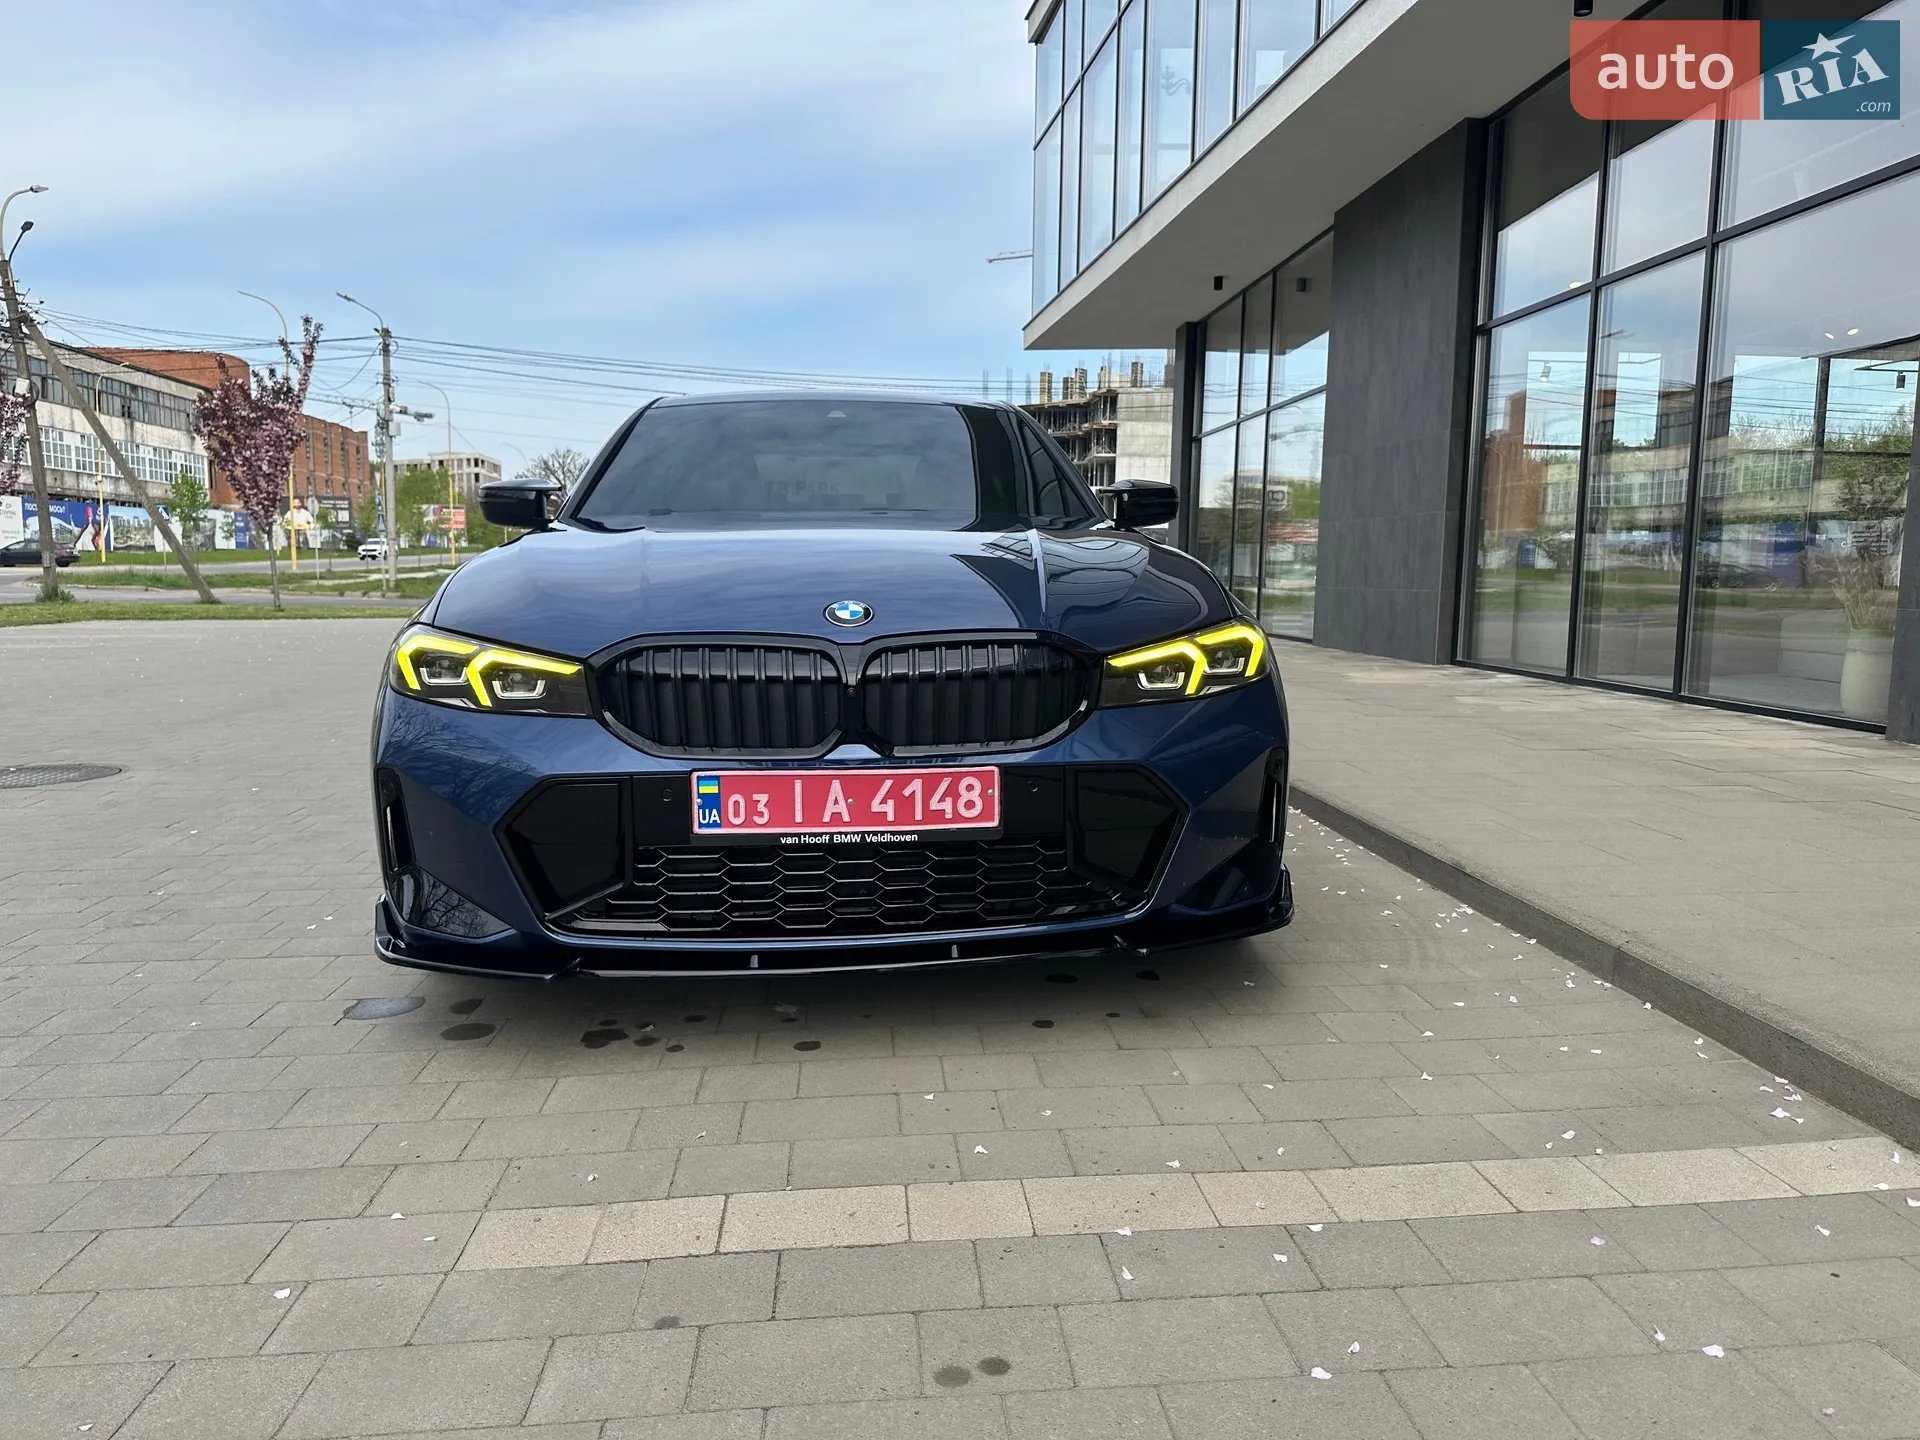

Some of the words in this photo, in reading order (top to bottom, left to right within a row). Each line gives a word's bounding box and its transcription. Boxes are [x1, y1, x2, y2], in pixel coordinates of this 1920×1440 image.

[726, 792, 771, 826] 03
[870, 776, 984, 823] 4148
[699, 808, 721, 824] UA
[780, 835, 799, 844] van
[800, 833, 830, 844] Hooff
[833, 833, 862, 844] BMW
[865, 832, 918, 843] Veldhoven
